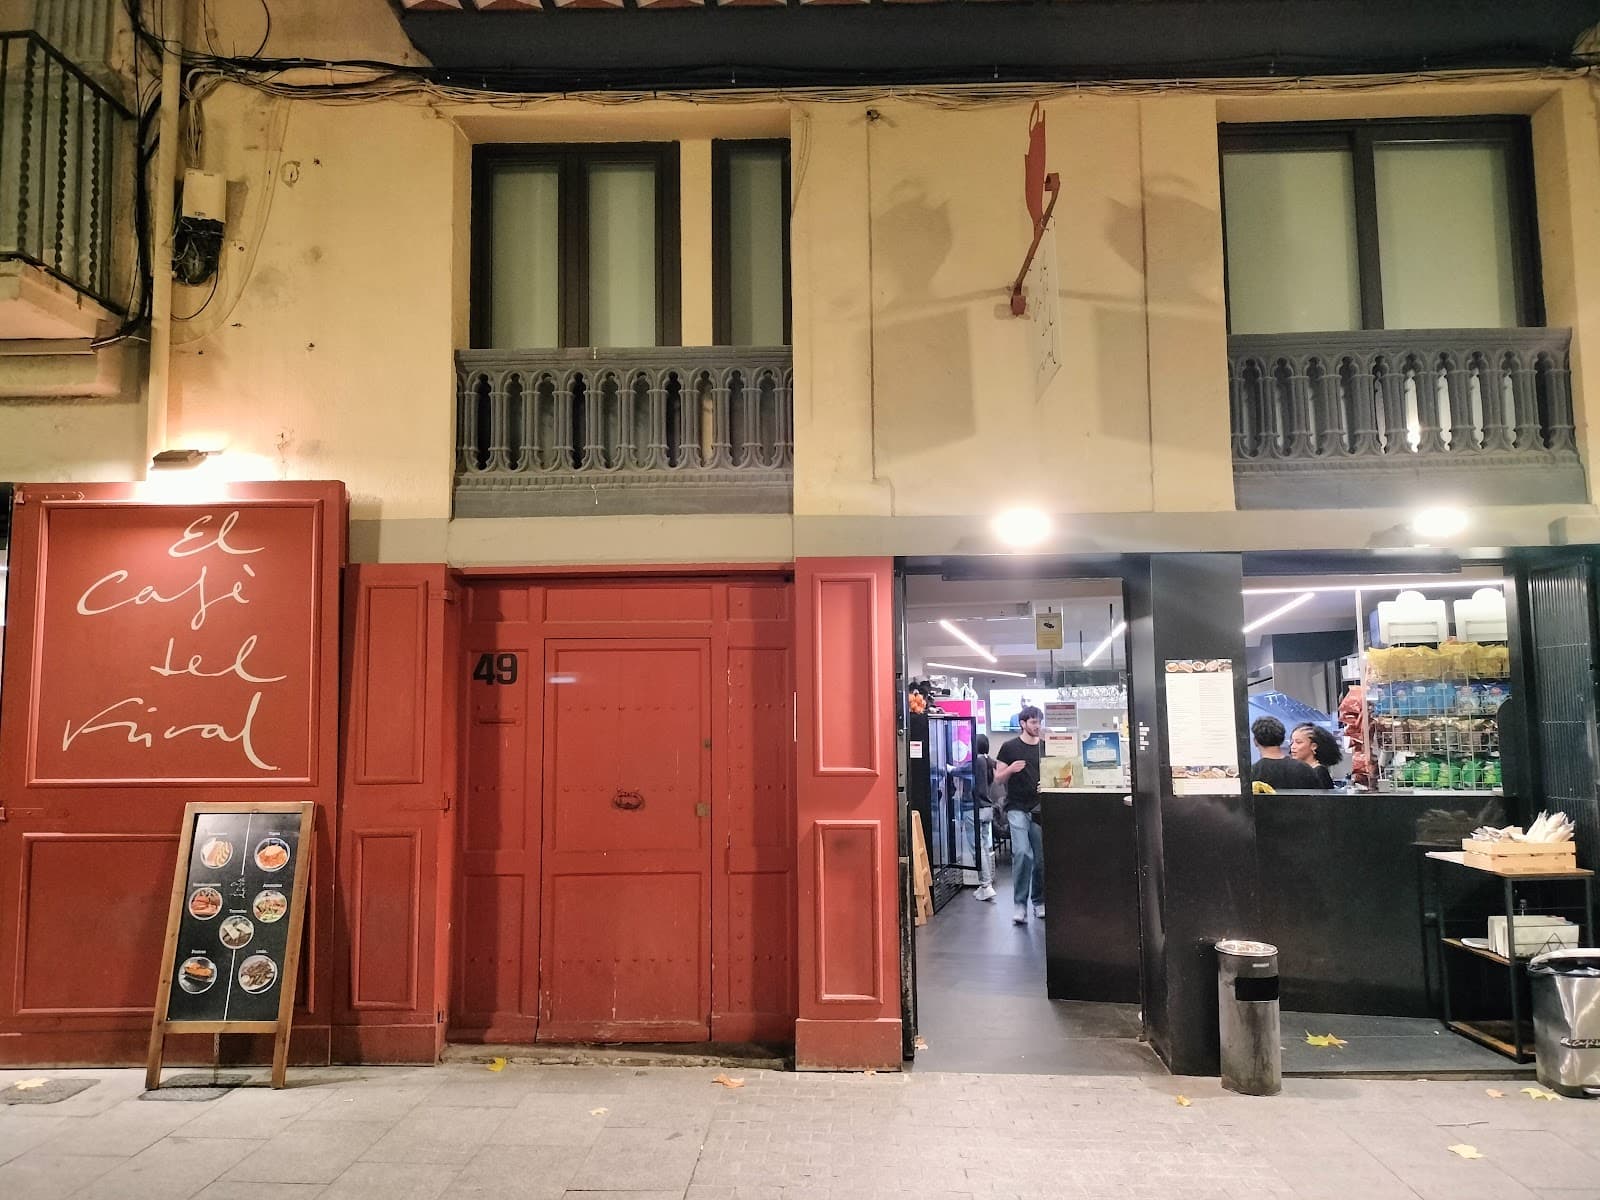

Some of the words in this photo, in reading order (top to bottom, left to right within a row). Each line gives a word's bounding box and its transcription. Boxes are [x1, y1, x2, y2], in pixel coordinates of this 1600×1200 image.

[168, 510, 265, 558] El
[77, 564, 256, 630] Cafè
[150, 634, 287, 683] del
[473, 653, 518, 686] 49
